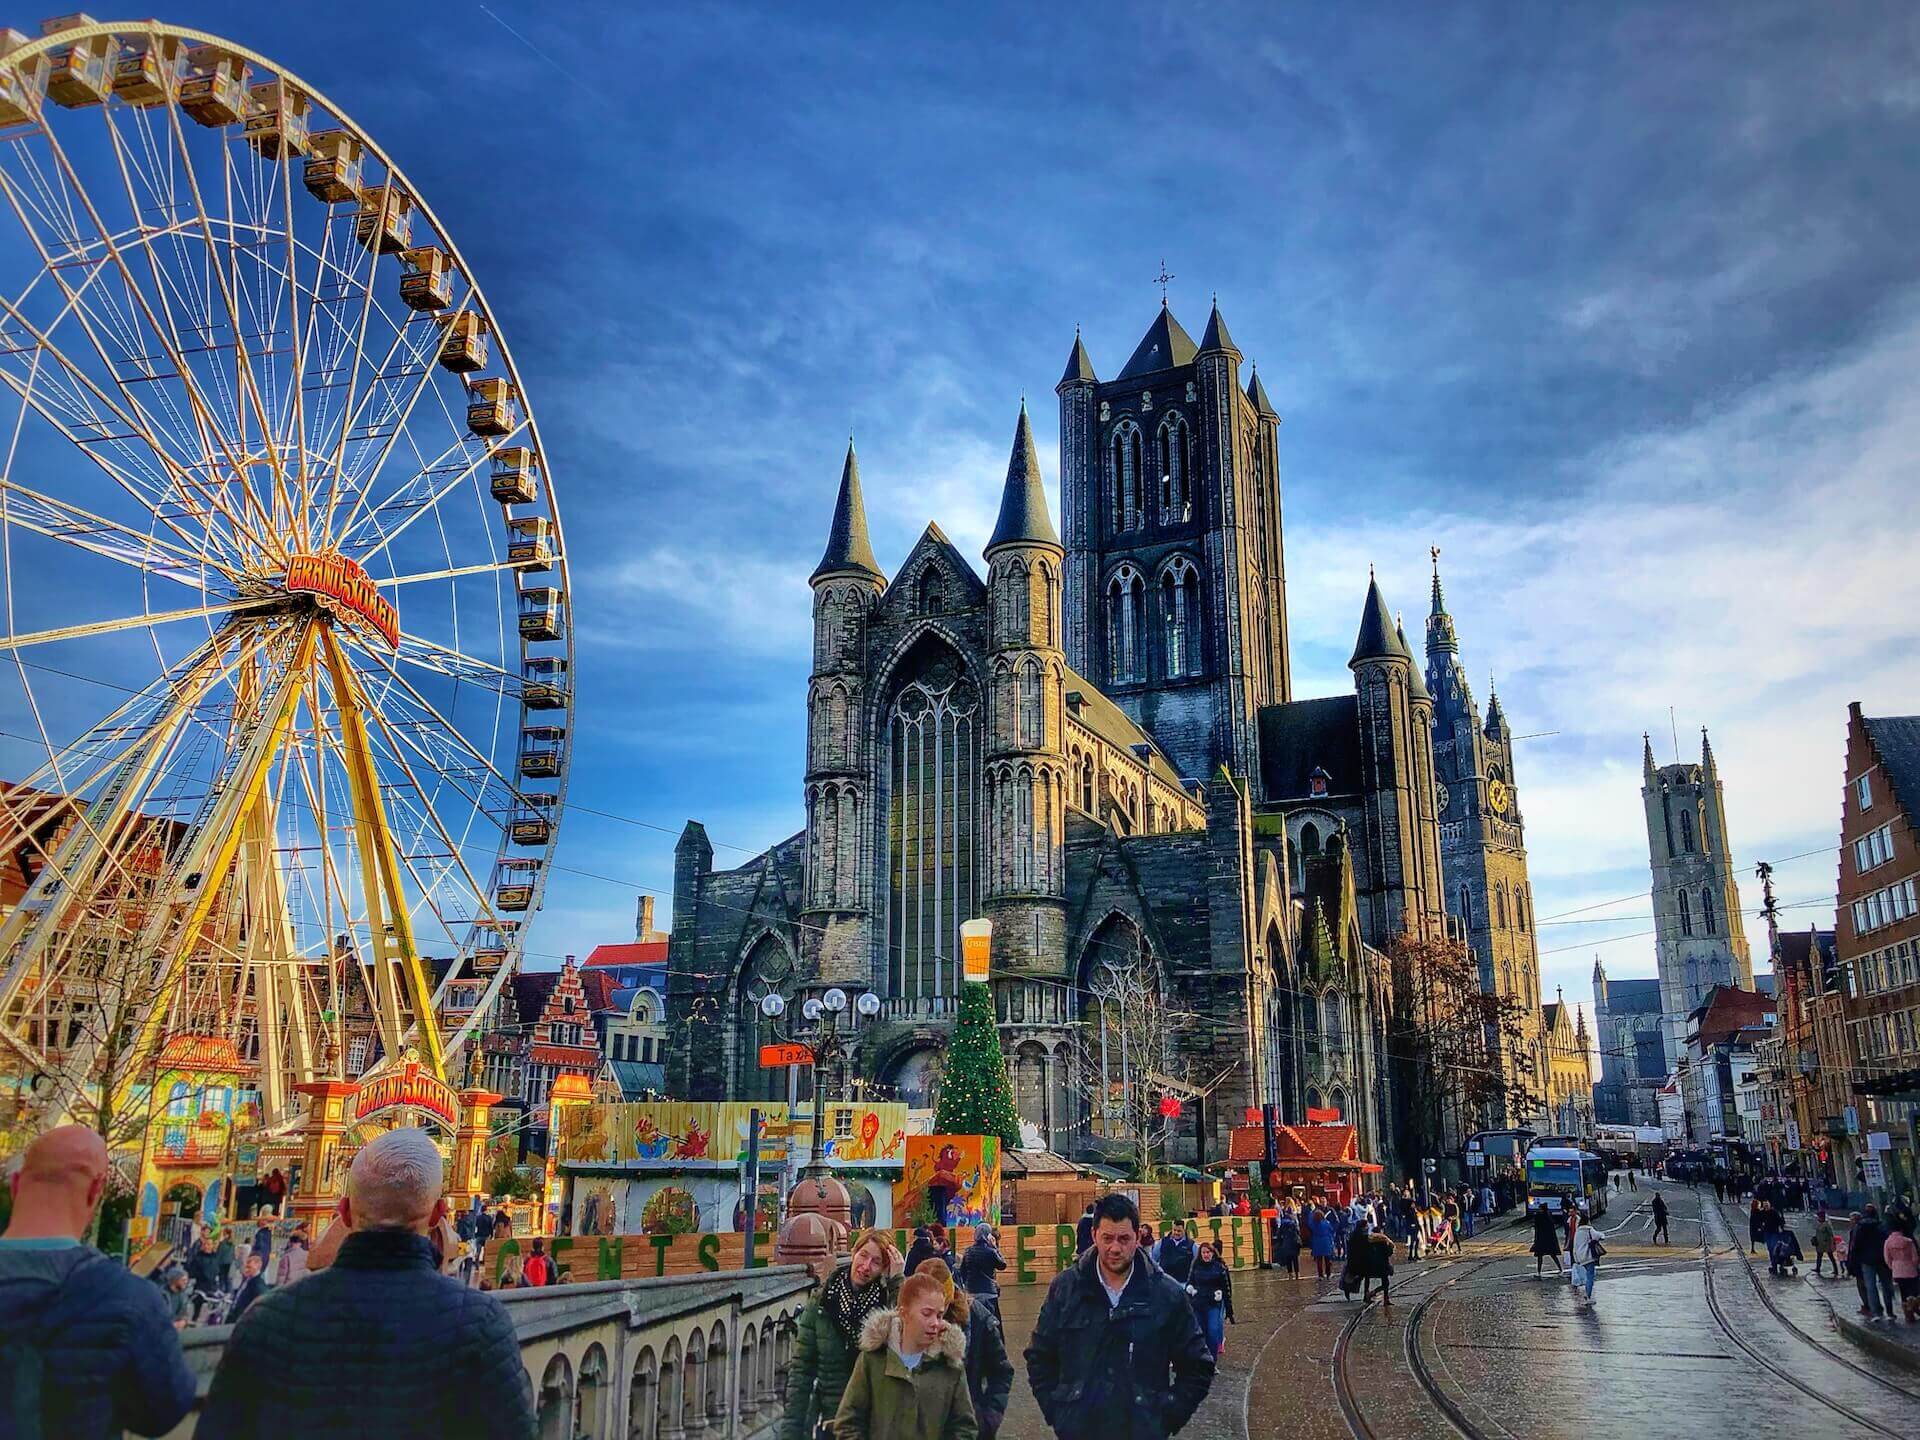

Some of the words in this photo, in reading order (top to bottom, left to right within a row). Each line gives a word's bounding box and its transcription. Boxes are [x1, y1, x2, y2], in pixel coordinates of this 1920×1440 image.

[290, 556, 343, 597] GRAND
[357, 1075, 403, 1118] GRAND
[402, 1062, 456, 1124] SOLEIL
